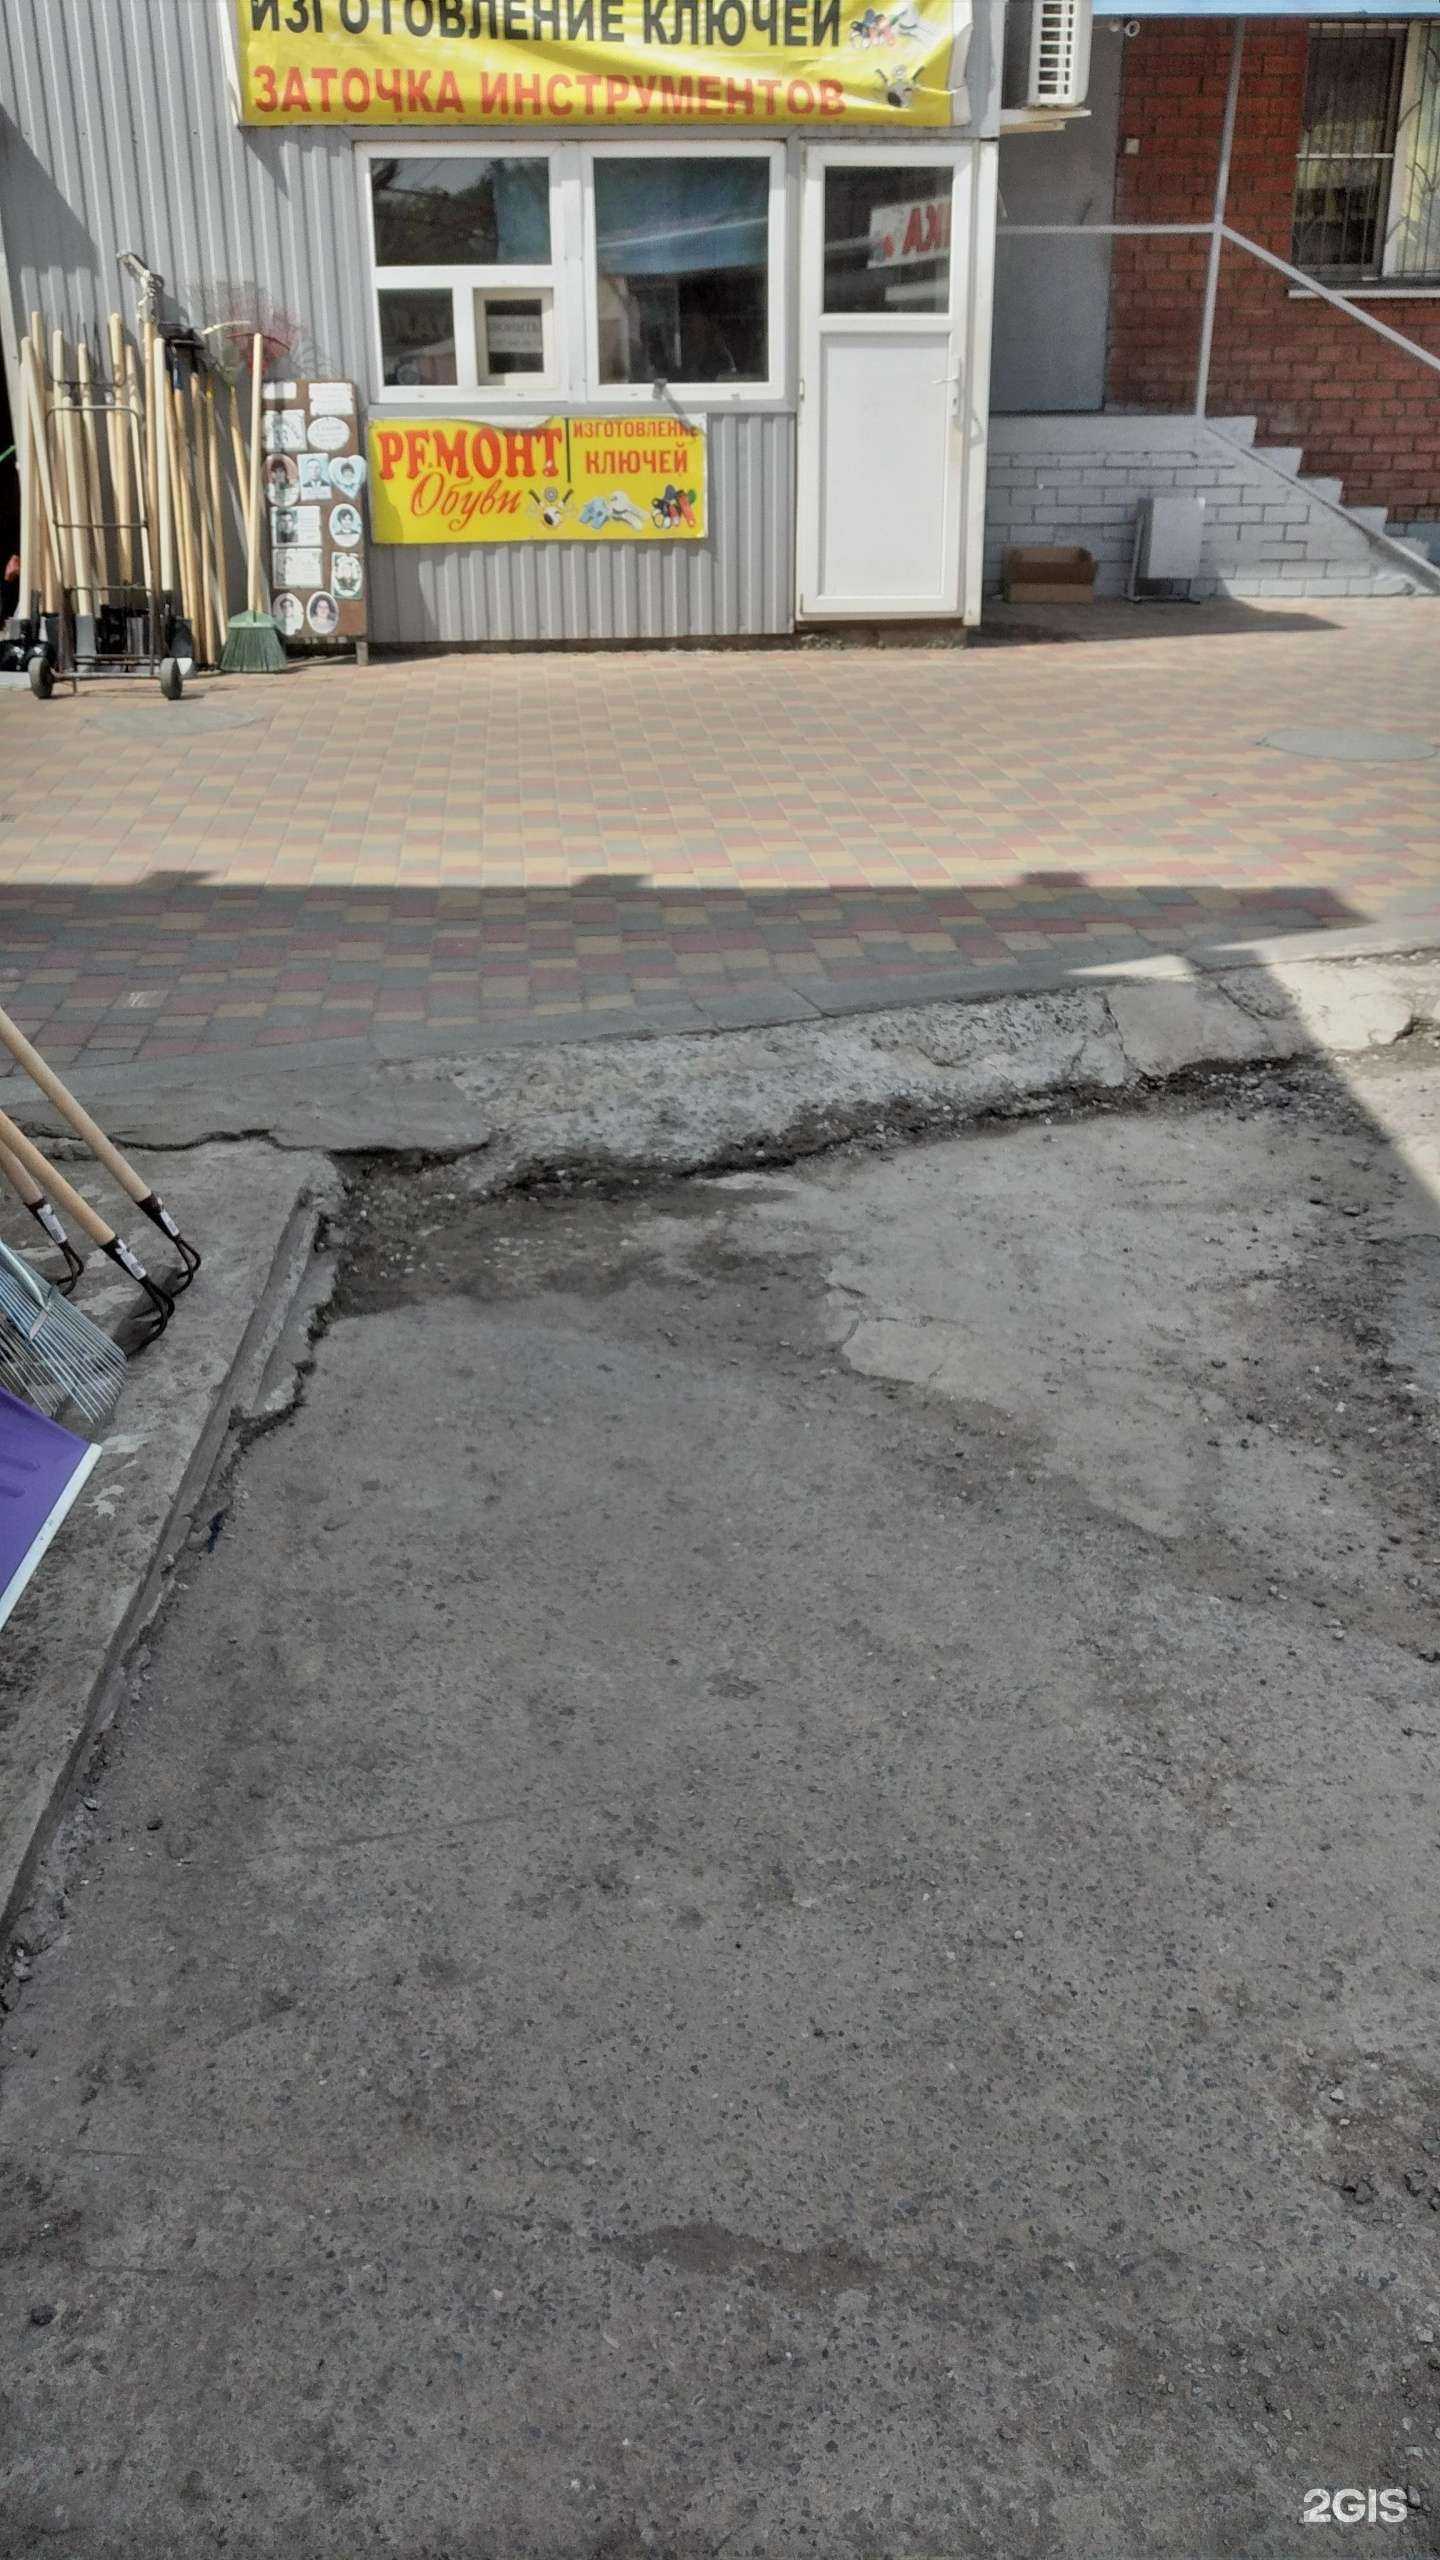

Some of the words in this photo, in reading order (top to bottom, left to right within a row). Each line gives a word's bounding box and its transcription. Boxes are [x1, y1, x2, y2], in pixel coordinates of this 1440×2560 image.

[254, 65, 465, 113] ЗАТОЧКА
[480, 70, 848, 116] ИНСТРУМЕНТОВ
[377, 427, 563, 480] РЕМОНТ
[585, 441, 688, 474] КЛЮЧЕЙ
[410, 472, 522, 531] Обуви
